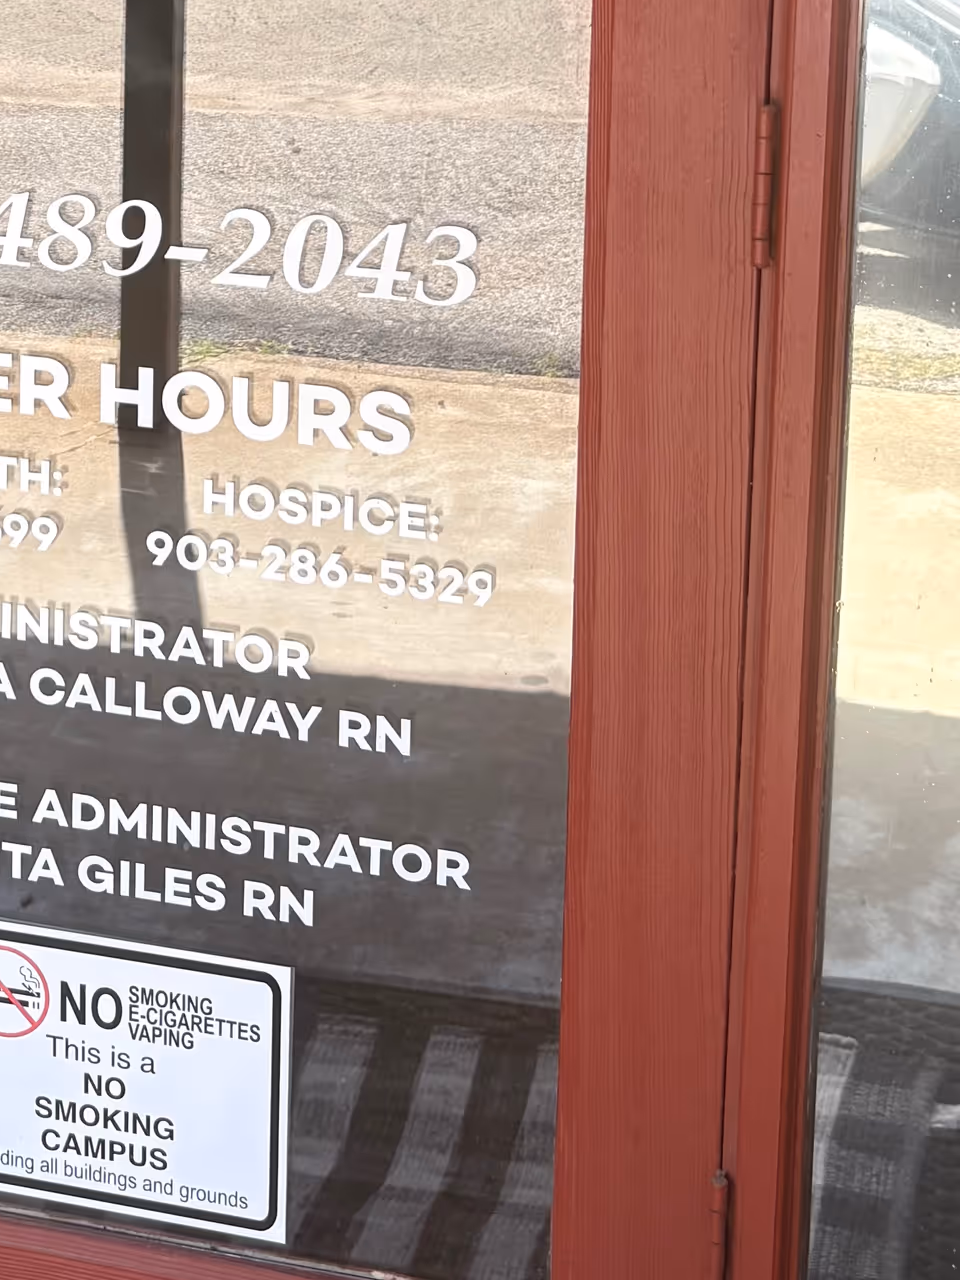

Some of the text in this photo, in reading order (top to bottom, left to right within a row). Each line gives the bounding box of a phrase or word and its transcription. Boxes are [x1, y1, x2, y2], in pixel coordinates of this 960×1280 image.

[100, 364, 413, 455] HOURS
[203, 478, 441, 540] HOSPICE:
[146, 531, 496, 607] 903-286-5329
[29, 667, 321, 741] CALLOWAY
[339, 710, 412, 756] RN
[33, 788, 471, 891] ADMINISTRATOR
[78, 855, 226, 911] GILES
[243, 880, 314, 927] RN
[60, 981, 123, 1030] NO
[128, 985, 213, 1015] SMOKING
[128, 1004, 261, 1043] E-CIGARETTES
[46, 1035, 156, 1074] This is a
[128, 1022, 194, 1050] VAPING
[83, 1073, 126, 1099] NO
[35, 1096, 175, 1141] SMOKING
[41, 1129, 168, 1171] CAMPUS
[40, 1156, 59, 1176] all
[64, 1163, 137, 1192] buildings
[142, 1176, 174, 1196] and
[179, 1184, 249, 1210] grounds
